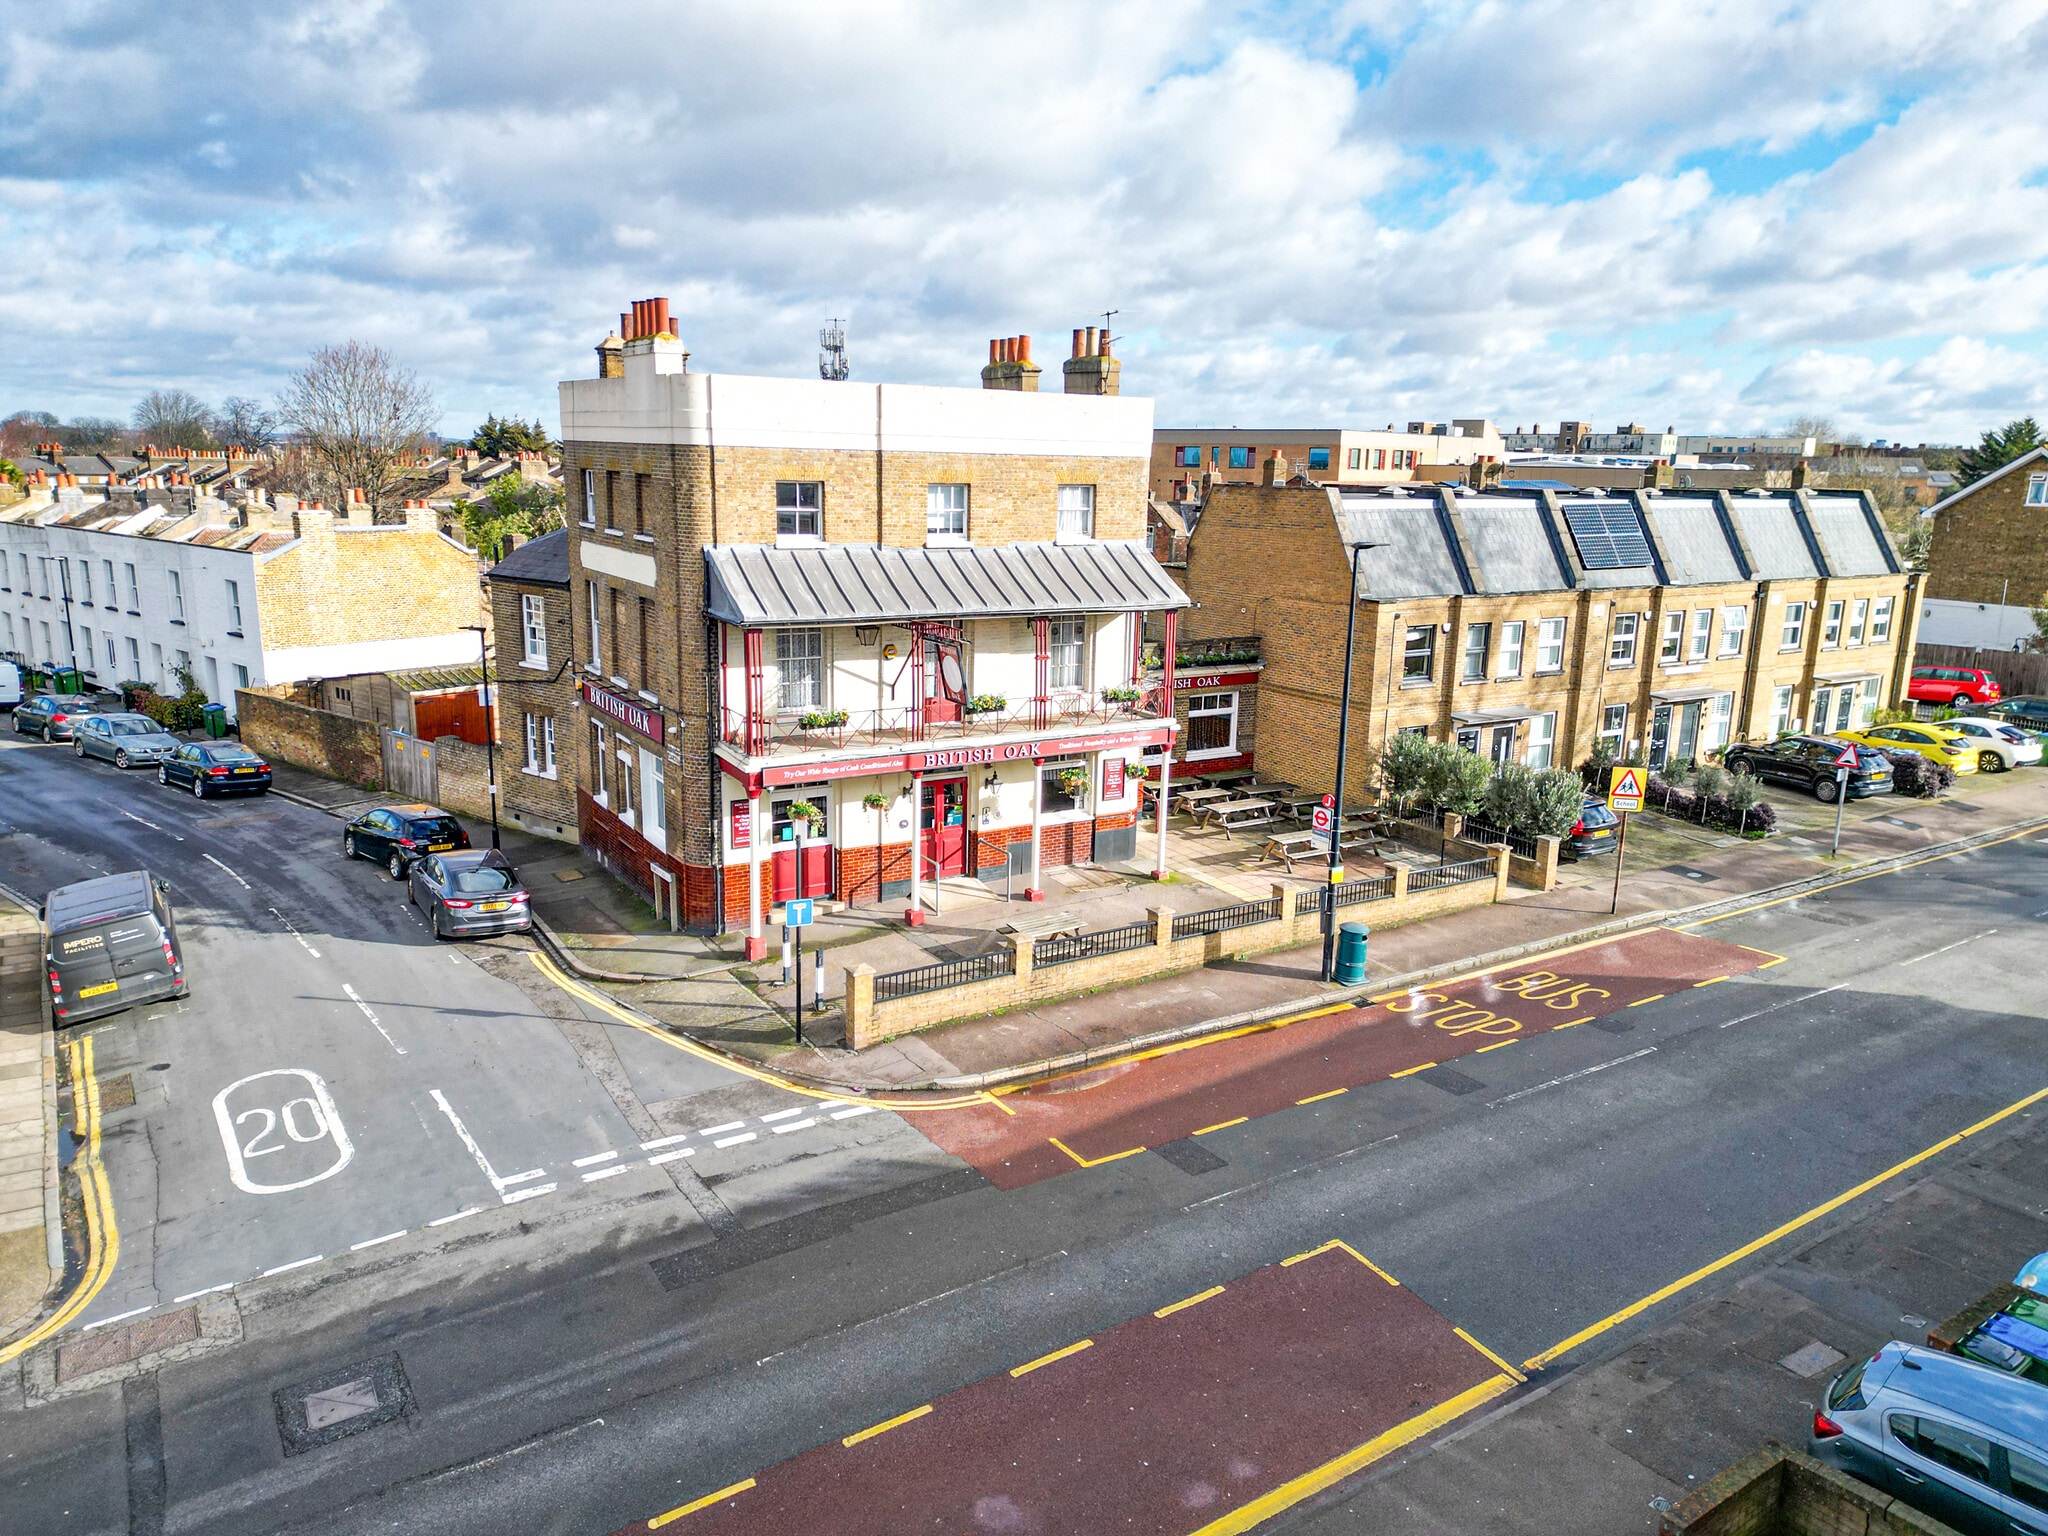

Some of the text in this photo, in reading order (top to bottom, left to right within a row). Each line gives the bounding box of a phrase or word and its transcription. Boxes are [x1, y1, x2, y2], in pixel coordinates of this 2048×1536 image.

[1197, 676, 1220, 687] OAK
[590, 687, 650, 734] BRITISH OAK
[925, 743, 1040, 767] BRITISH OAK
[784, 771, 794, 779] Try
[807, 768, 821, 776] Wide
[822, 766, 839, 774] Range
[1325, 797, 1331, 806] J
[63, 936, 102, 949] IMPERO
[65, 942, 104, 954] FACILITIES
[1490, 971, 1611, 1009] BUS
[1385, 993, 1523, 1037] STOP
[236, 1097, 329, 1158] 20
